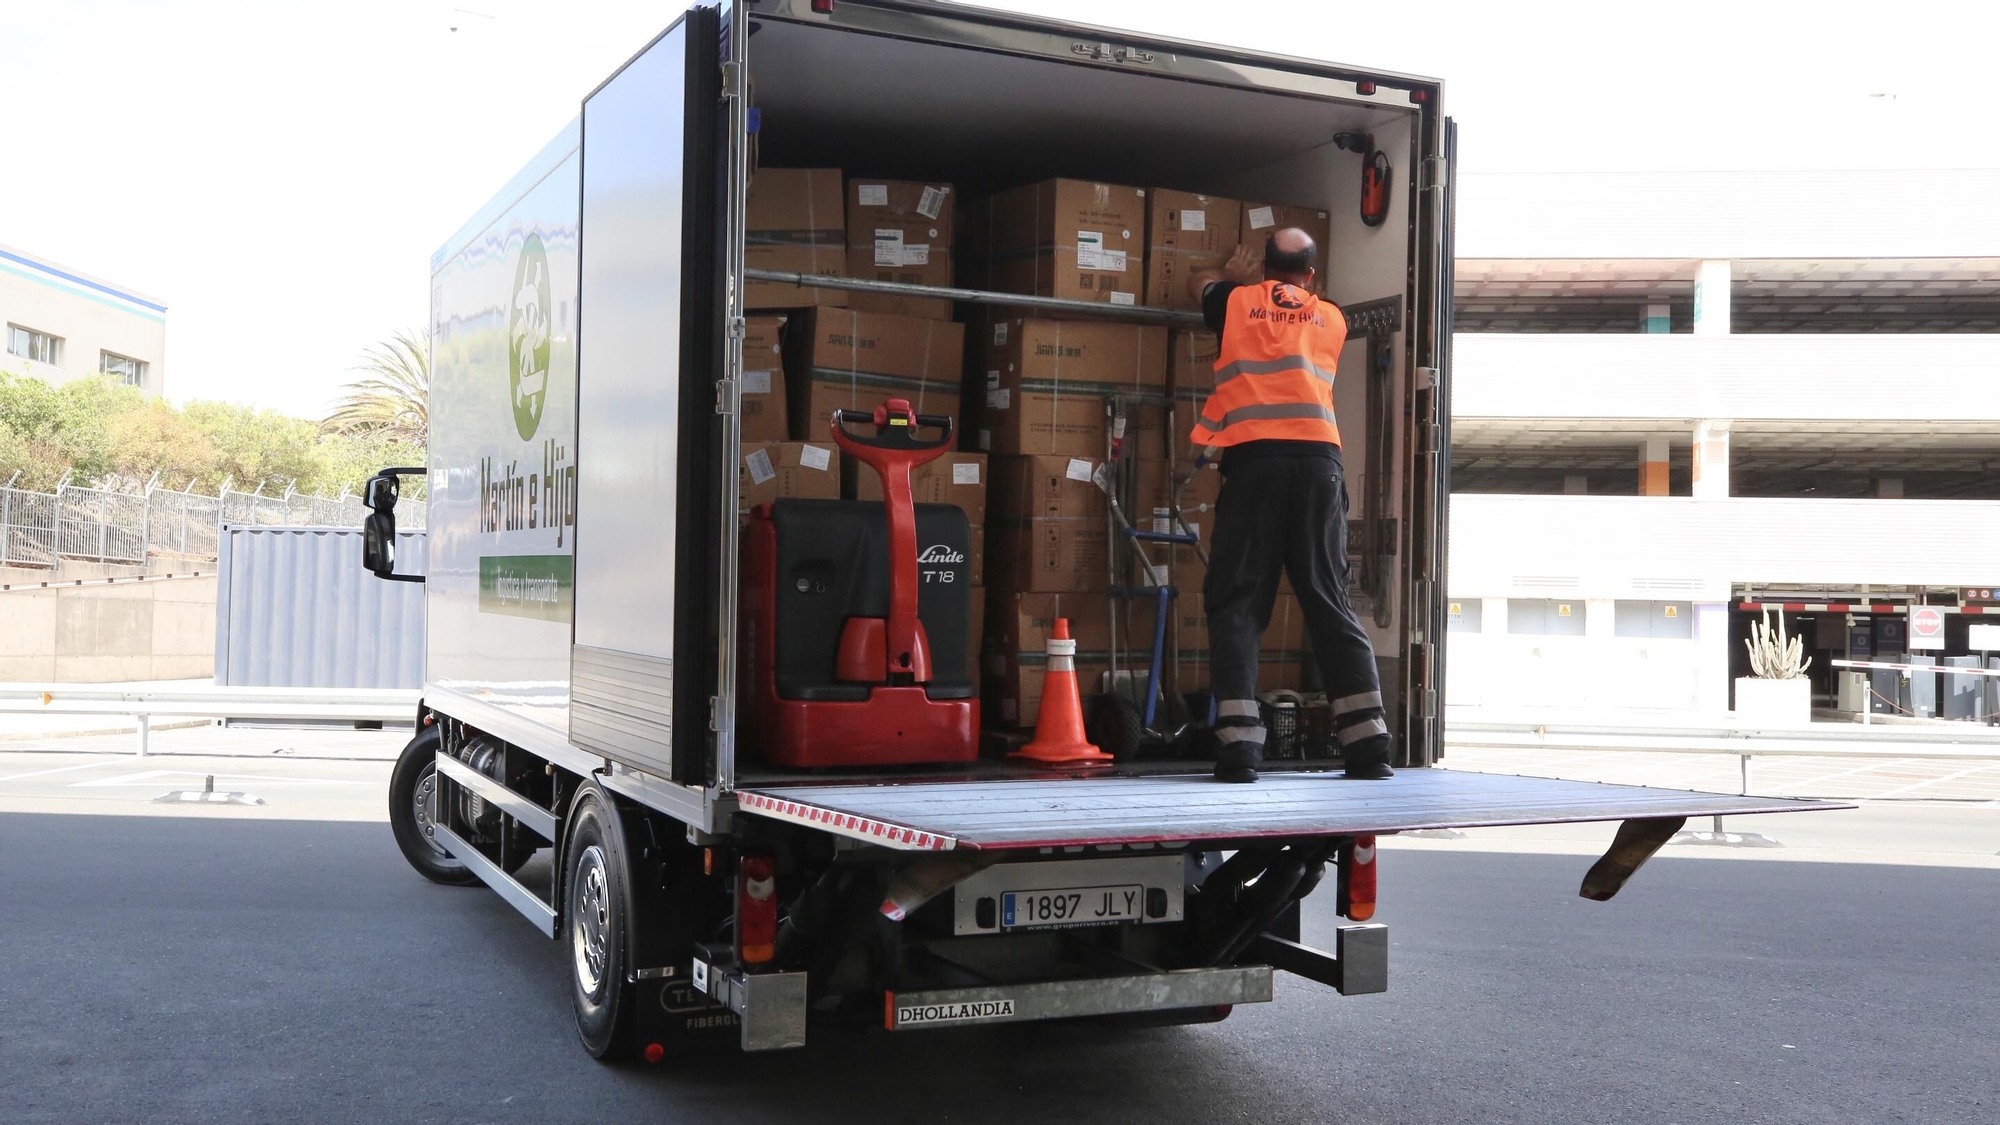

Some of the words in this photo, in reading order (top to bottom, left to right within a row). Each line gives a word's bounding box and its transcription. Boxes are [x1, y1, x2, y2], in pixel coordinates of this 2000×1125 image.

[1288, 312, 1296, 324] e
[480, 456, 524, 533] Martín
[528, 473, 538, 529] e
[917, 544, 964, 563] Linde
[1914, 618, 1940, 626] STOP
[1006, 912, 1013, 920] E
[1026, 894, 1082, 921] 1897
[1094, 891, 1136, 918] JLY
[1026, 919, 1120, 931] www.gruporivera.es
[900, 1001, 1014, 1023] DHOLLANDIA
[687, 1014, 742, 1029] FIBERGL
